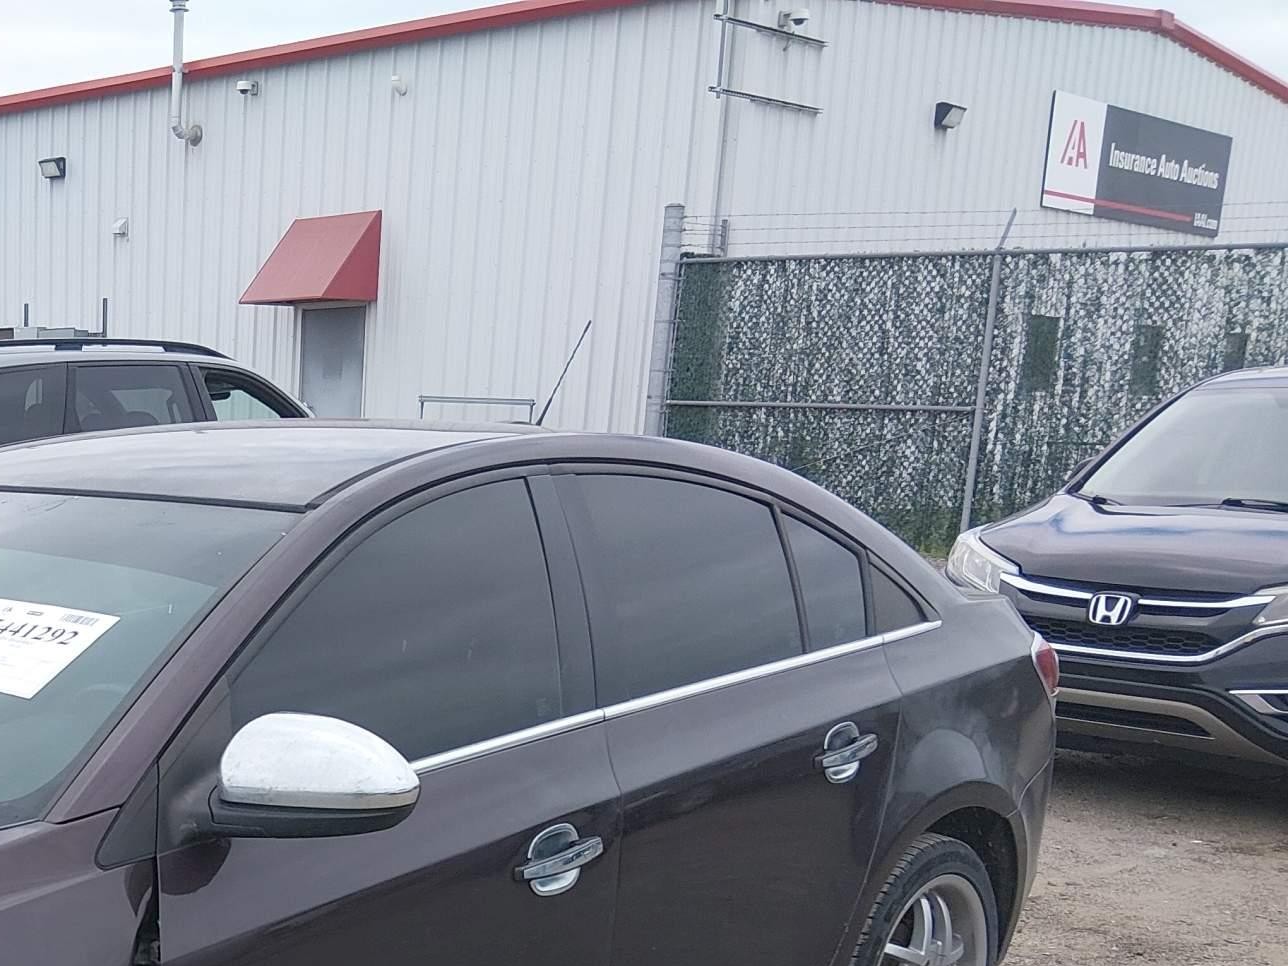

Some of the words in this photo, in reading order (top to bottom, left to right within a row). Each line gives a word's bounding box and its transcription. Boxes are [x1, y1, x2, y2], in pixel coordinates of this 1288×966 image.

[1109, 142, 1158, 176] Insurance
[1157, 154, 1181, 181] Auto
[1179, 159, 1220, 190] Auctions
